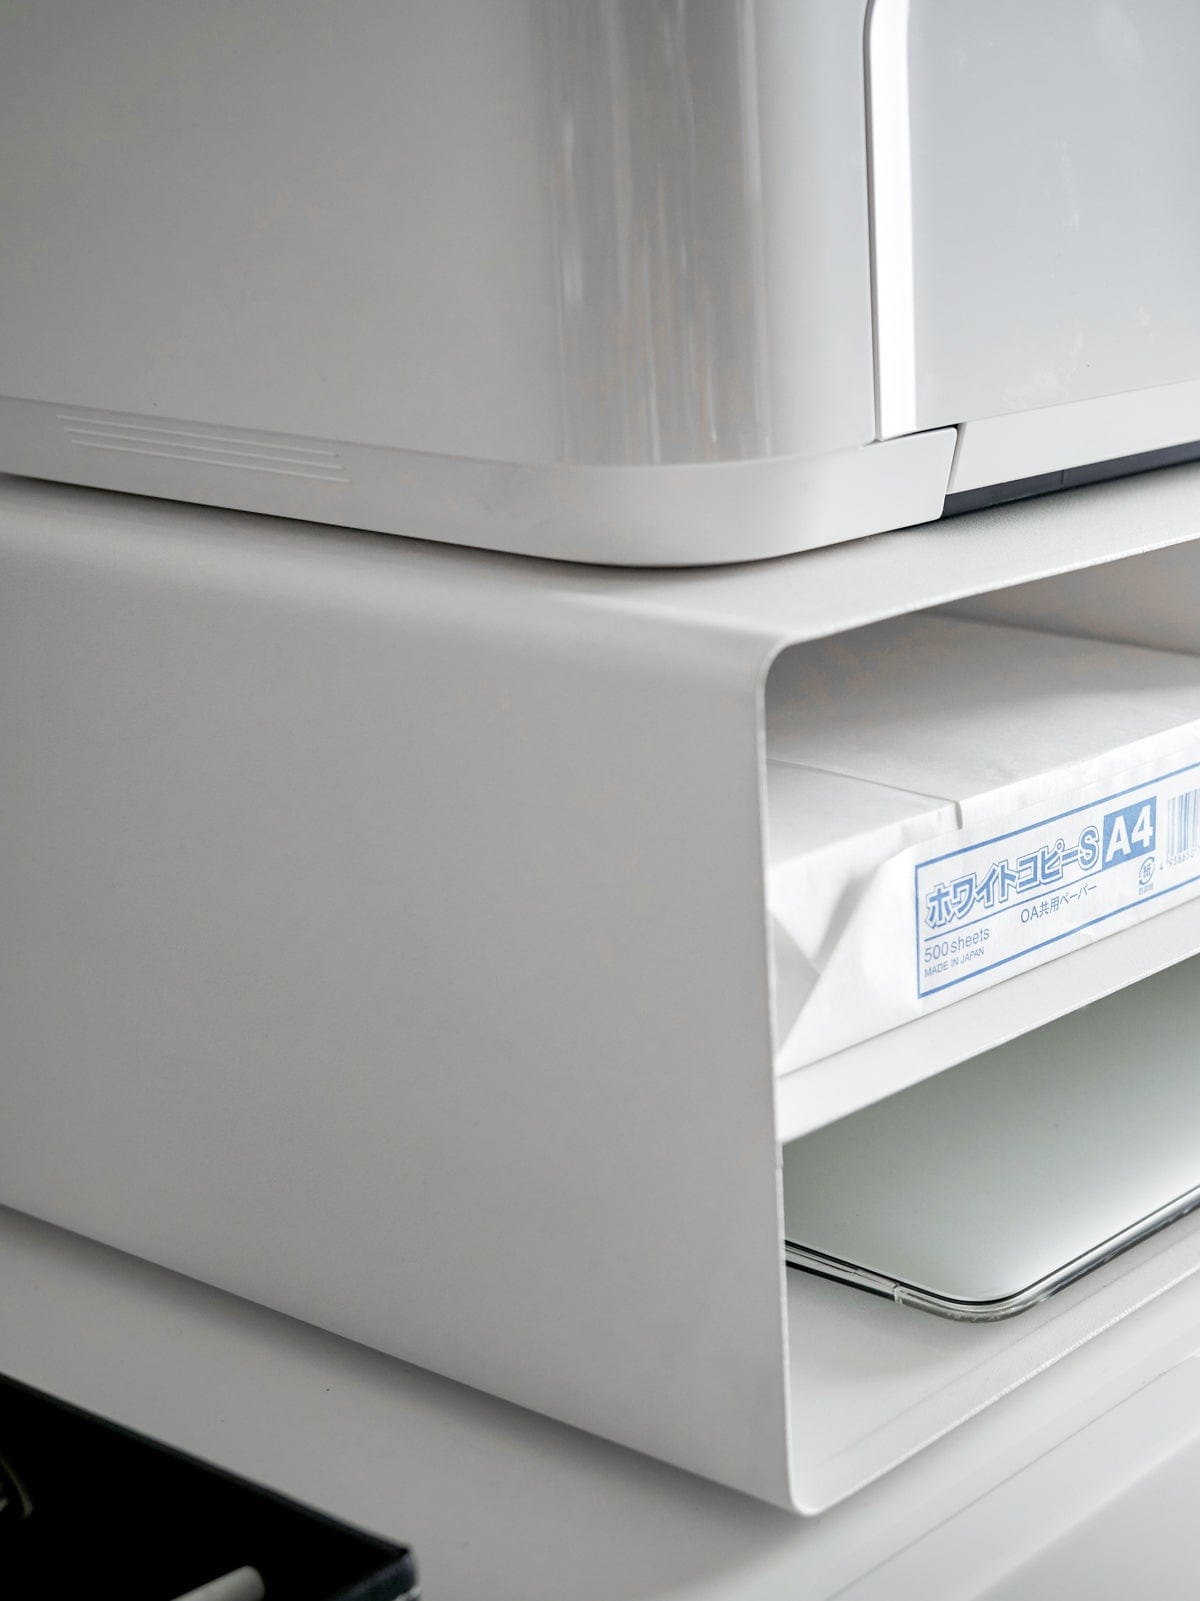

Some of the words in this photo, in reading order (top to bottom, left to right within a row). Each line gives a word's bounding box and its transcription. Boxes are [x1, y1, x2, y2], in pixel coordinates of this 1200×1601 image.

[1105, 806, 1153, 863] A4
[1021, 884, 1097, 924] OA共用ペーパー
[924, 961, 949, 977] MADE
[951, 957, 959, 967] IN
[961, 946, 985, 964] JAPAN
